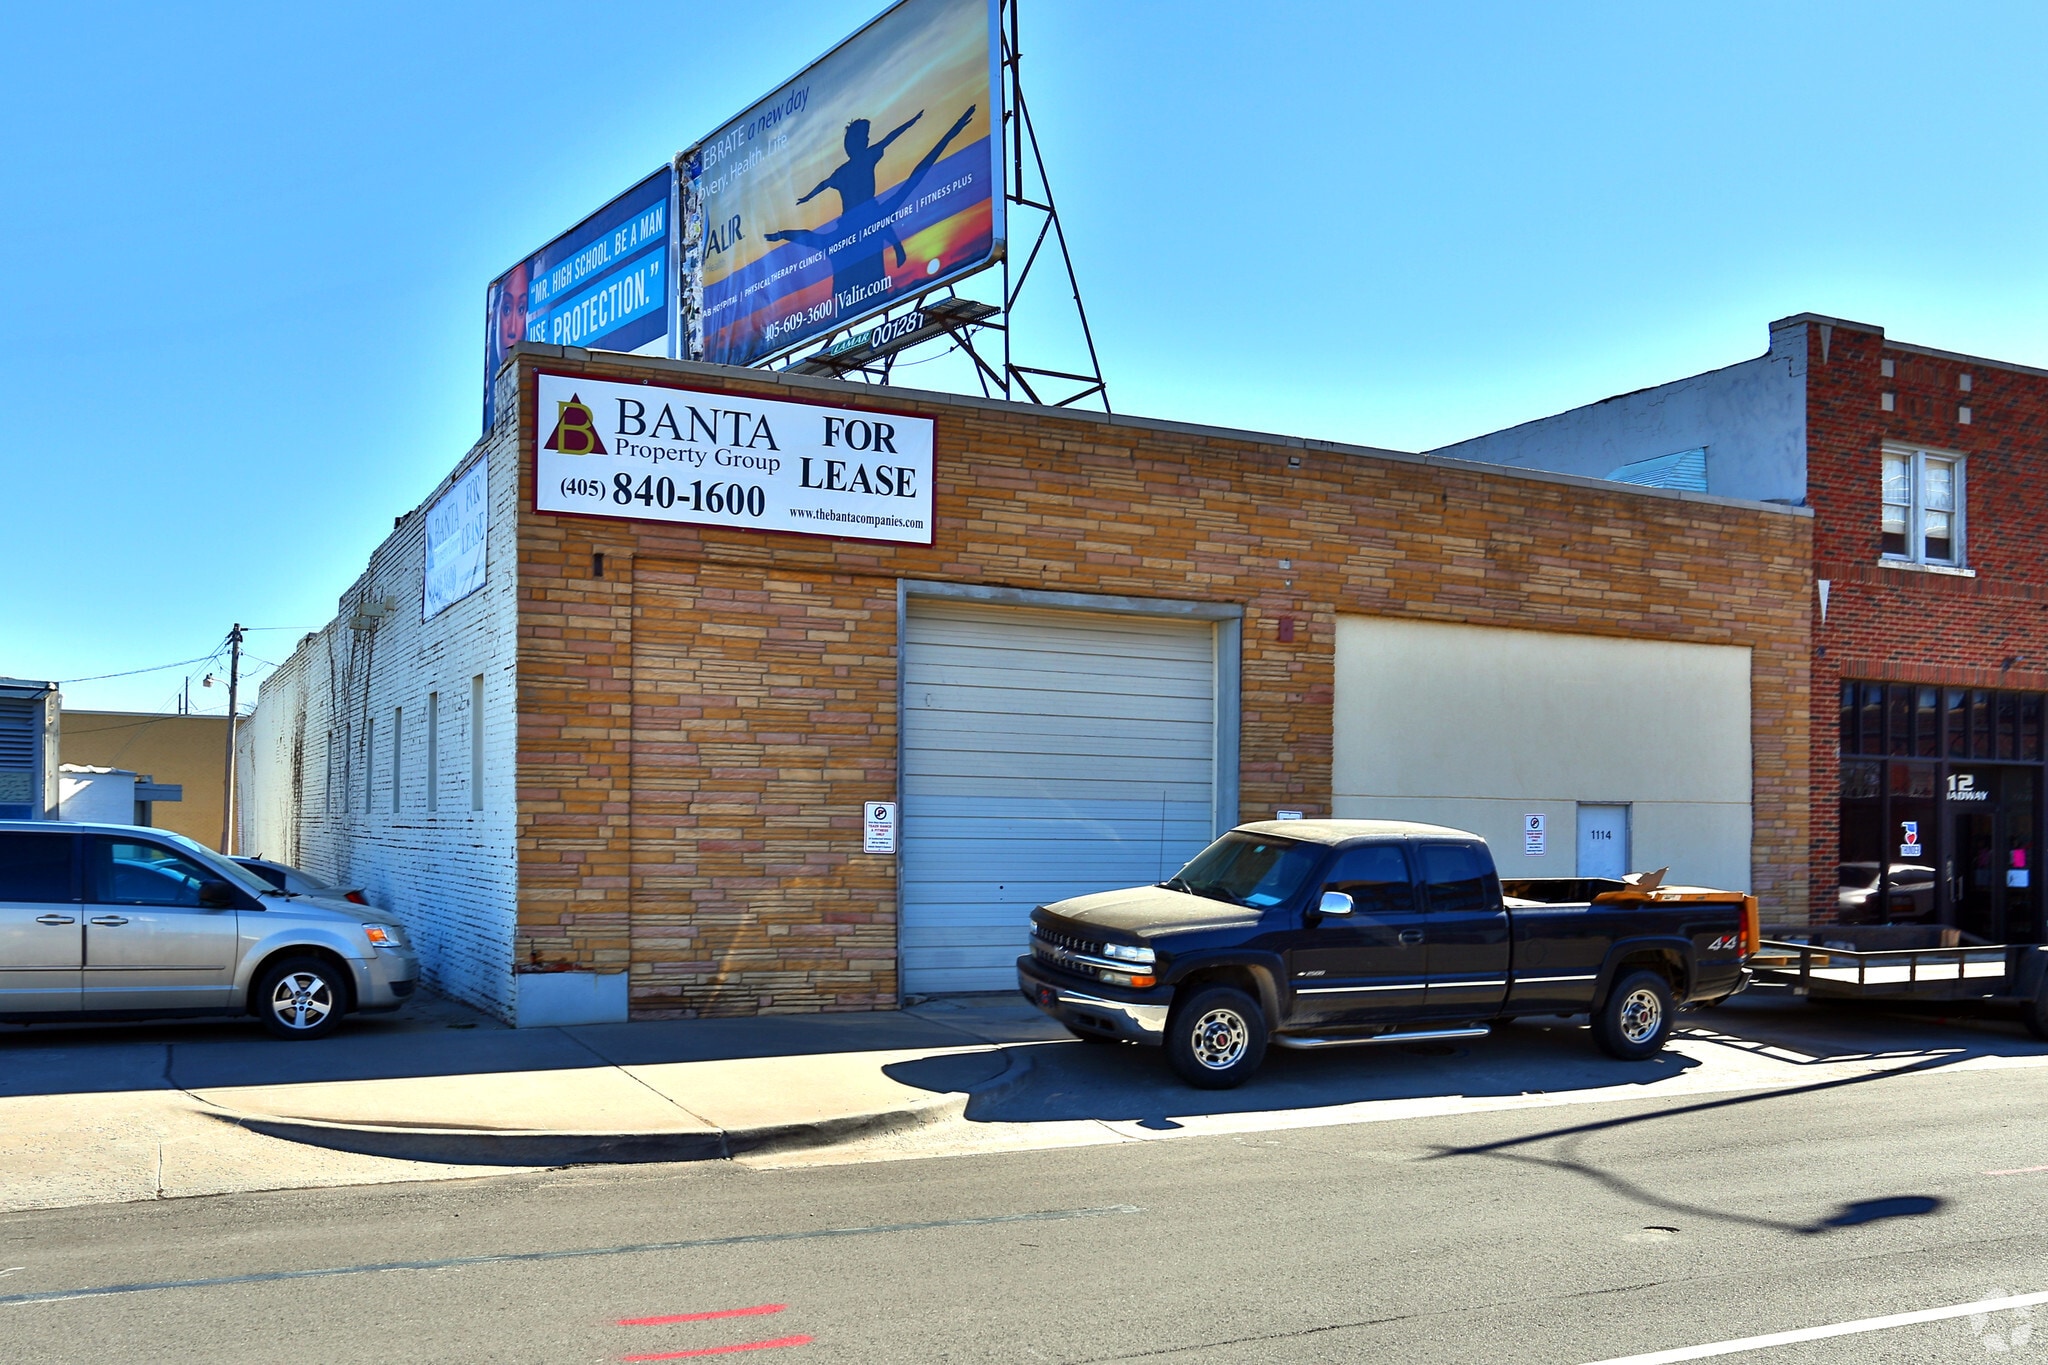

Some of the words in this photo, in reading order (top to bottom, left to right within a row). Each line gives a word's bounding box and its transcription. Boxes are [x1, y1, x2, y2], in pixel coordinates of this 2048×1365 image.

[702, 125, 744, 172] EBRATE
[747, 124, 755, 140] a
[757, 105, 784, 134] new
[785, 86, 809, 116] day
[730, 146, 765, 181] Health.
[552, 262, 572, 294] HIGH
[575, 241, 611, 280] SCHOOL.
[615, 228, 627, 256] BE
[630, 223, 637, 247] A
[640, 207, 663, 242] MAN
[744, 278, 770, 298] PHYSICAL
[770, 263, 798, 286] THERAPY
[799, 250, 822, 269] CLINICS
[828, 234, 856, 255] HOSPICE
[863, 204, 913, 238] ACUPUNCTURE
[920, 184, 951, 208] FITNESS
[952, 173, 973, 192] PLUS
[833, 332, 869, 353] LAMAR
[615, 398, 780, 451] BANTA
[822, 415, 898, 454] FOR
[615, 438, 706, 468] Property
[714, 447, 781, 476] Group
[560, 476, 606, 501] (405)
[612, 472, 765, 518] 840-1600
[799, 457, 917, 498] LEASE
[790, 508, 923, 529] www.thebantacompanies.com
[1947, 774, 1974, 791] 12
[1591, 830, 1611, 840] 1114
